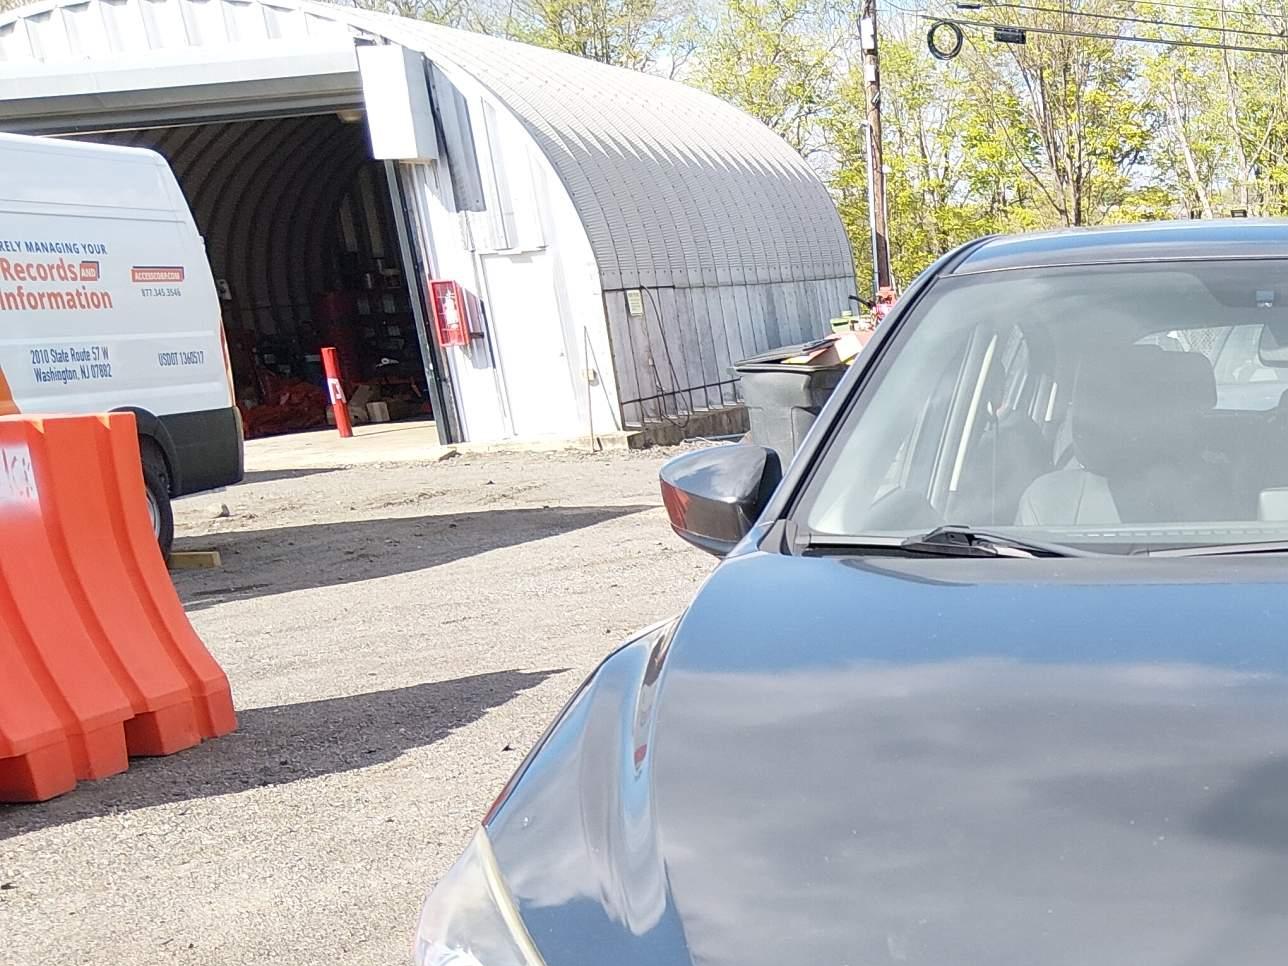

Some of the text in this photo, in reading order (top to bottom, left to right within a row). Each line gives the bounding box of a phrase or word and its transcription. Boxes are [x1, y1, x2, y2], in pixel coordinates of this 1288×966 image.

[24, 241, 80, 254] MANAGING
[81, 243, 108, 255] YOUR
[0, 257, 78, 281] Records
[0, 285, 113, 310] Information
[31, 346, 109, 364] 2010 State Route 57 W
[80, 364, 90, 380] NJ
